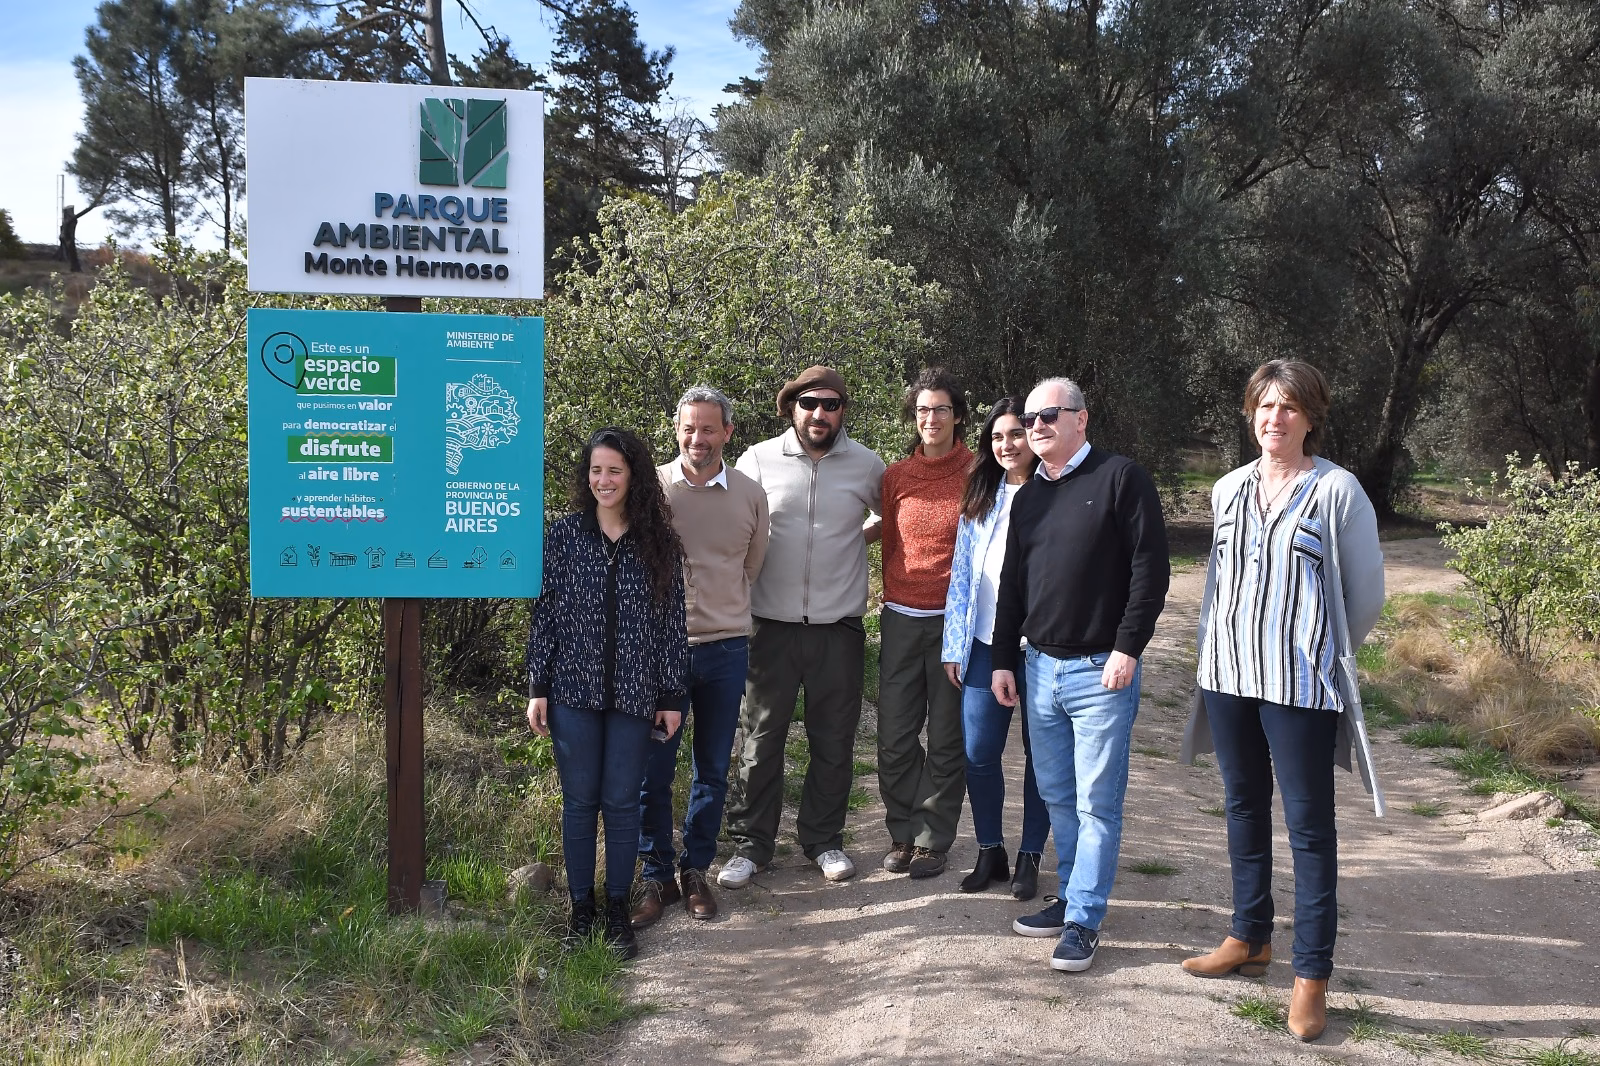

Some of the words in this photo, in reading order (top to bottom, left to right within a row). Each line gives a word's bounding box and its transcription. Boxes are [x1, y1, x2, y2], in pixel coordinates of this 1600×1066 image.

[374, 192, 508, 225] PARQUE
[313, 222, 508, 253] AMBIENTAL
[304, 252, 388, 276] Monte
[396, 255, 509, 281] Hermoso
[446, 332, 500, 341] MINISTERIO
[501, 333, 515, 342] DE
[311, 342, 336, 353] Este
[339, 345, 351, 354] es
[355, 345, 370, 354] un
[446, 340, 495, 349] AMBIENTE
[304, 356, 380, 376] espacio
[303, 373, 362, 391] verde
[296, 402, 312, 410] que
[313, 402, 345, 410] pusimos
[358, 399, 393, 411] valor
[282, 422, 301, 431] para
[304, 419, 387, 432] democratizar
[389, 423, 397, 432] el
[300, 438, 381, 457] disfrute
[298, 472, 306, 480] al
[307, 467, 339, 481] aire
[342, 467, 380, 481] libre
[445, 481, 492, 490] GOBIERNO
[494, 482, 507, 490] DE
[508, 482, 520, 491] LA
[296, 495, 302, 503] y
[303, 494, 343, 503] aprender
[344, 495, 376, 503] hábitos
[445, 491, 494, 500] PROVINCIA
[495, 492, 508, 500] DE
[281, 505, 385, 518] sustentables
[445, 500, 521, 517] BUENOS
[444, 518, 498, 533] AIRES
